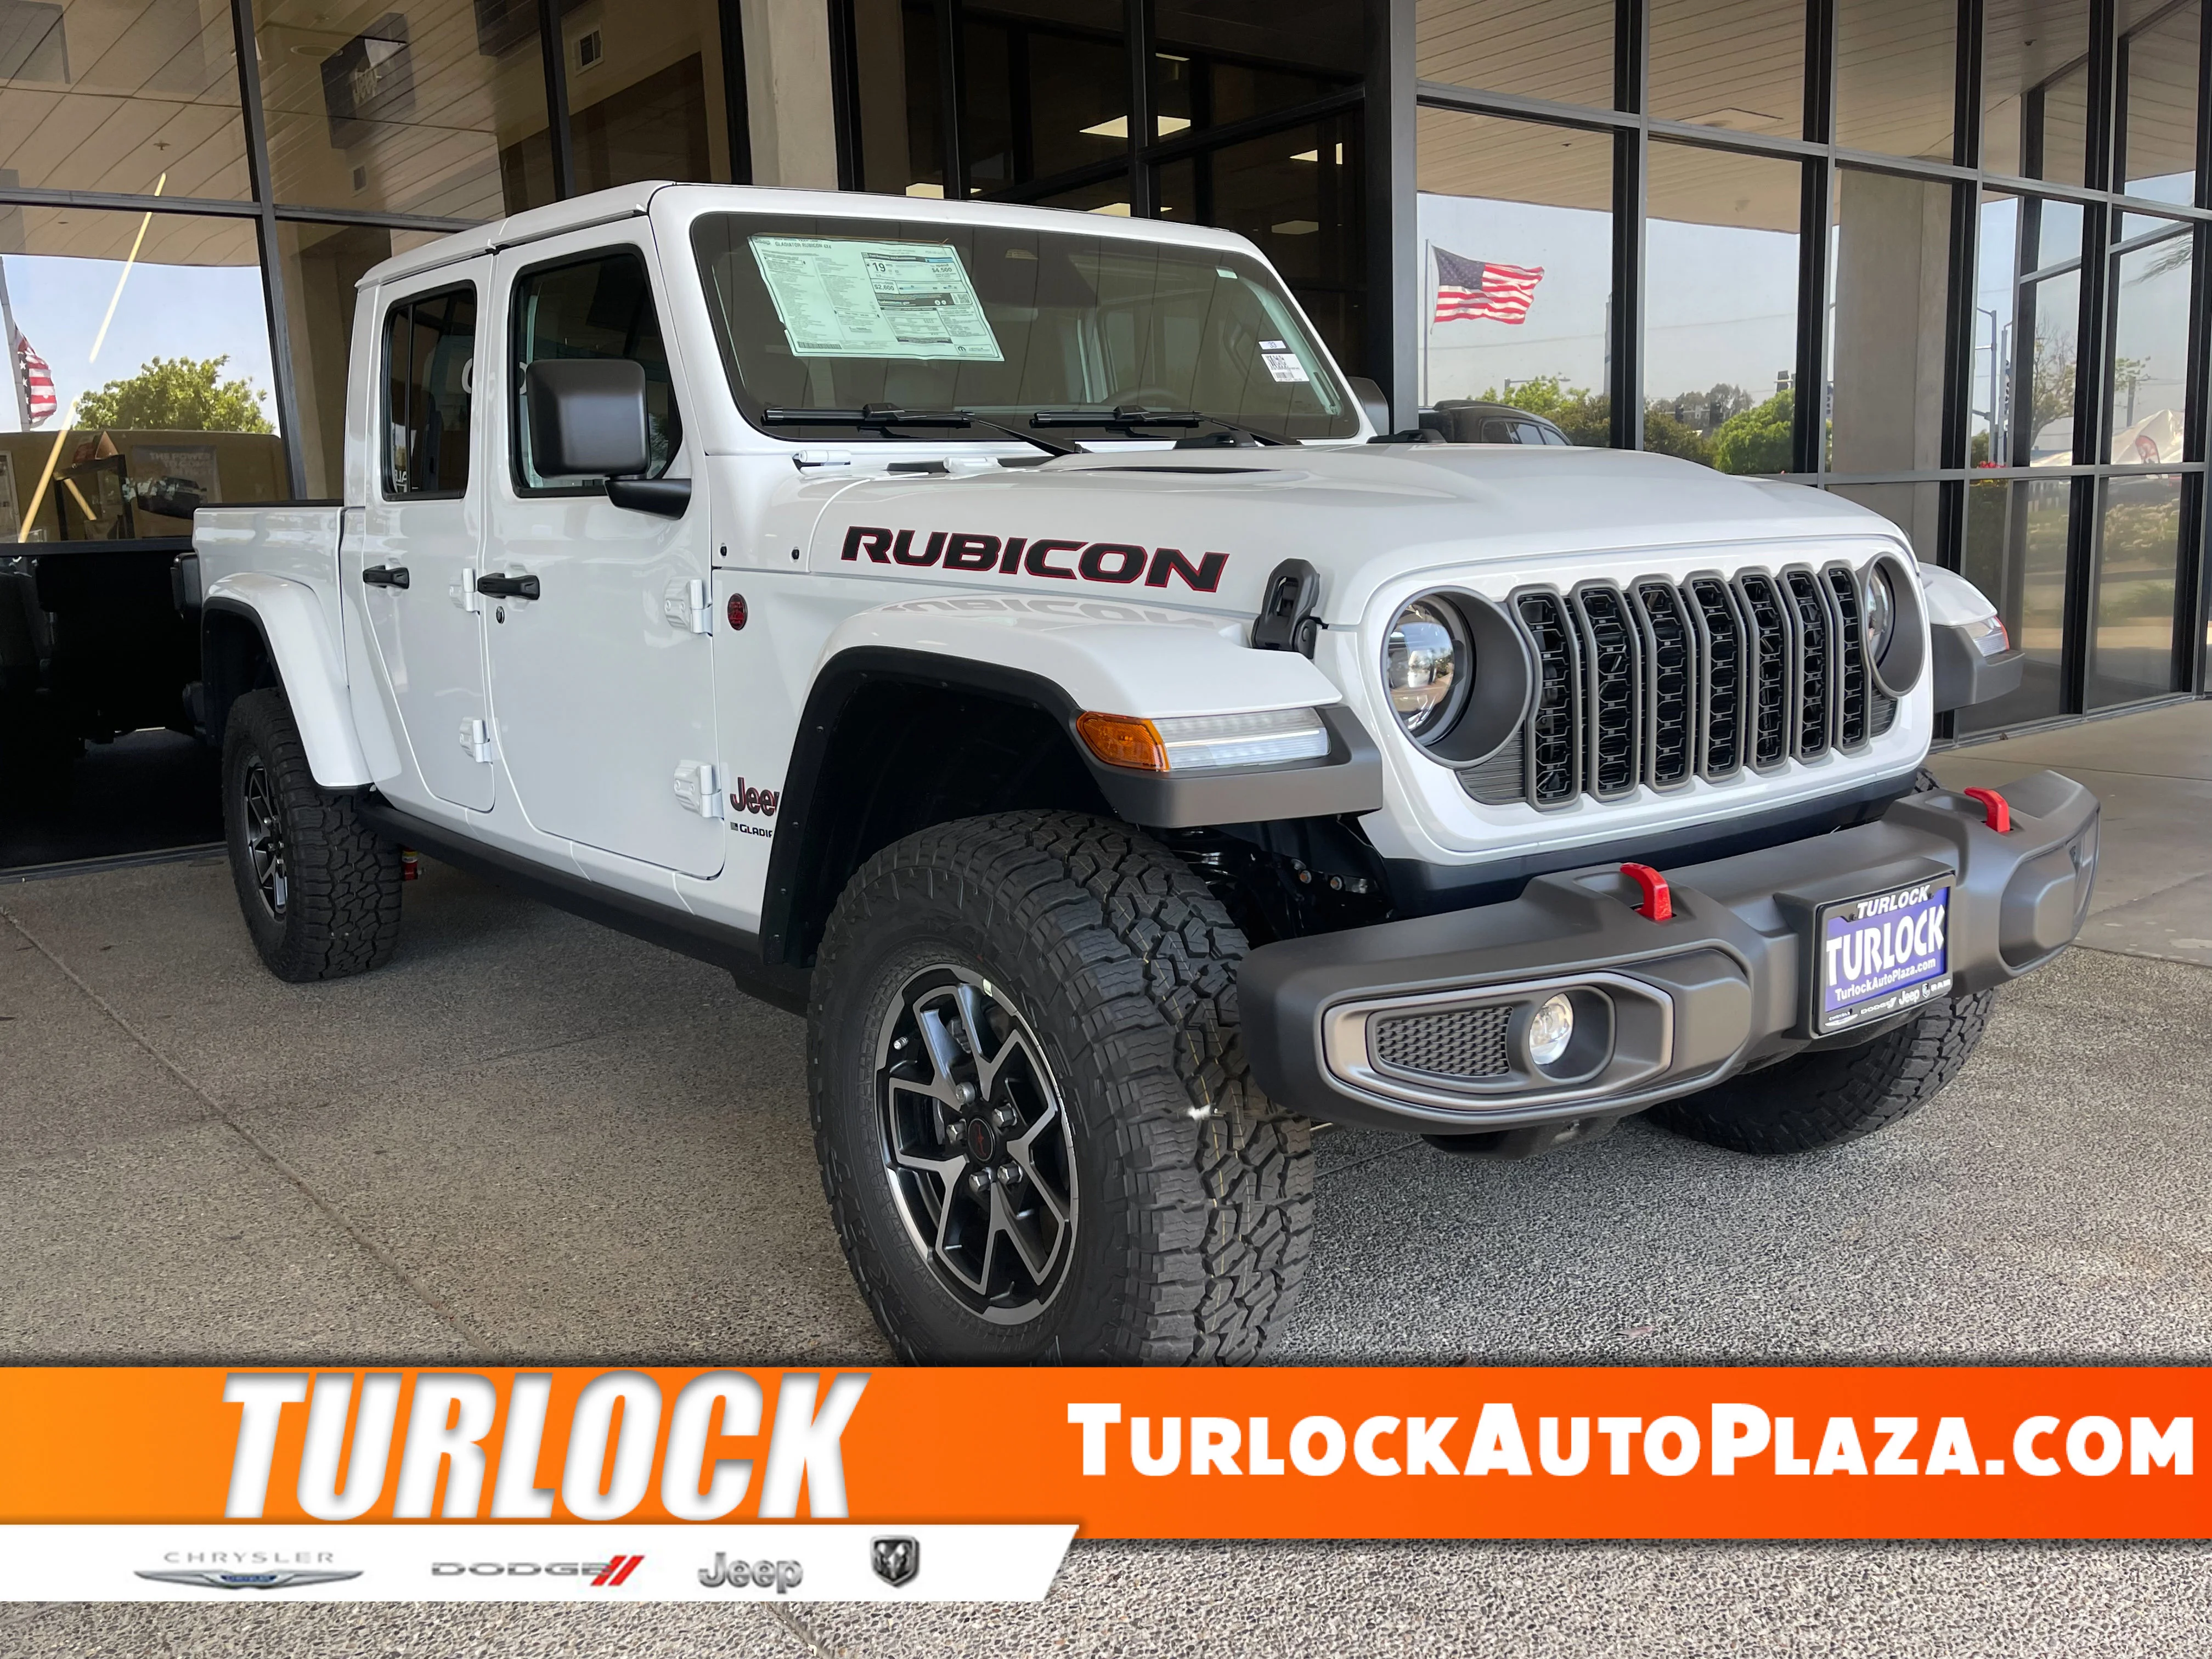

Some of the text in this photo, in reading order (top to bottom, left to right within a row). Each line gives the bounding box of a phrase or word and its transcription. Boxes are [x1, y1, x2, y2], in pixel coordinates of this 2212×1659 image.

[872, 262, 885, 272] 19
[841, 526, 1230, 592] RUBICON
[1857, 884, 1931, 919] TURLOCK
[1826, 904, 1945, 986] TURLOCK
[1835, 958, 1936, 1001] TurlockAutoPlaza.com
[1898, 989, 1920, 1006] Jeep
